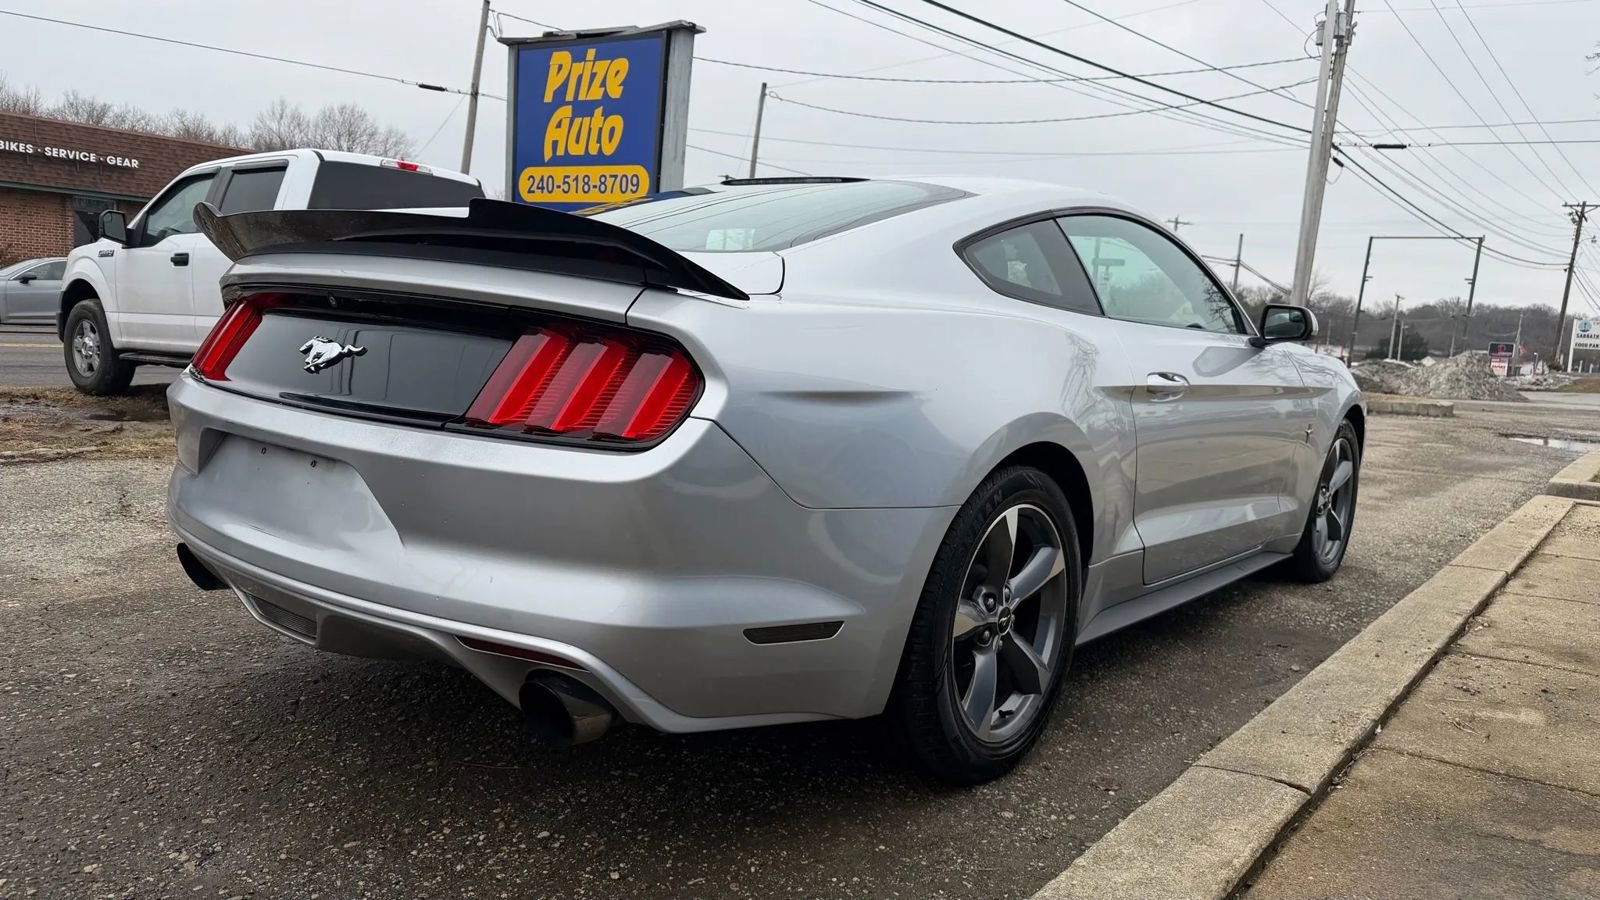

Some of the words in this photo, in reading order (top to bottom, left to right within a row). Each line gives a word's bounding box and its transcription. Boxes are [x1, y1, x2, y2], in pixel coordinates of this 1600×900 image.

[543, 48, 629, 103] Prize
[0, 140, 34, 154] BIKES
[44, 146, 97, 163] SERVICE
[106, 155, 140, 169] GEAR
[543, 105, 624, 163] Auto
[527, 174, 640, 195] 240-518-8709
